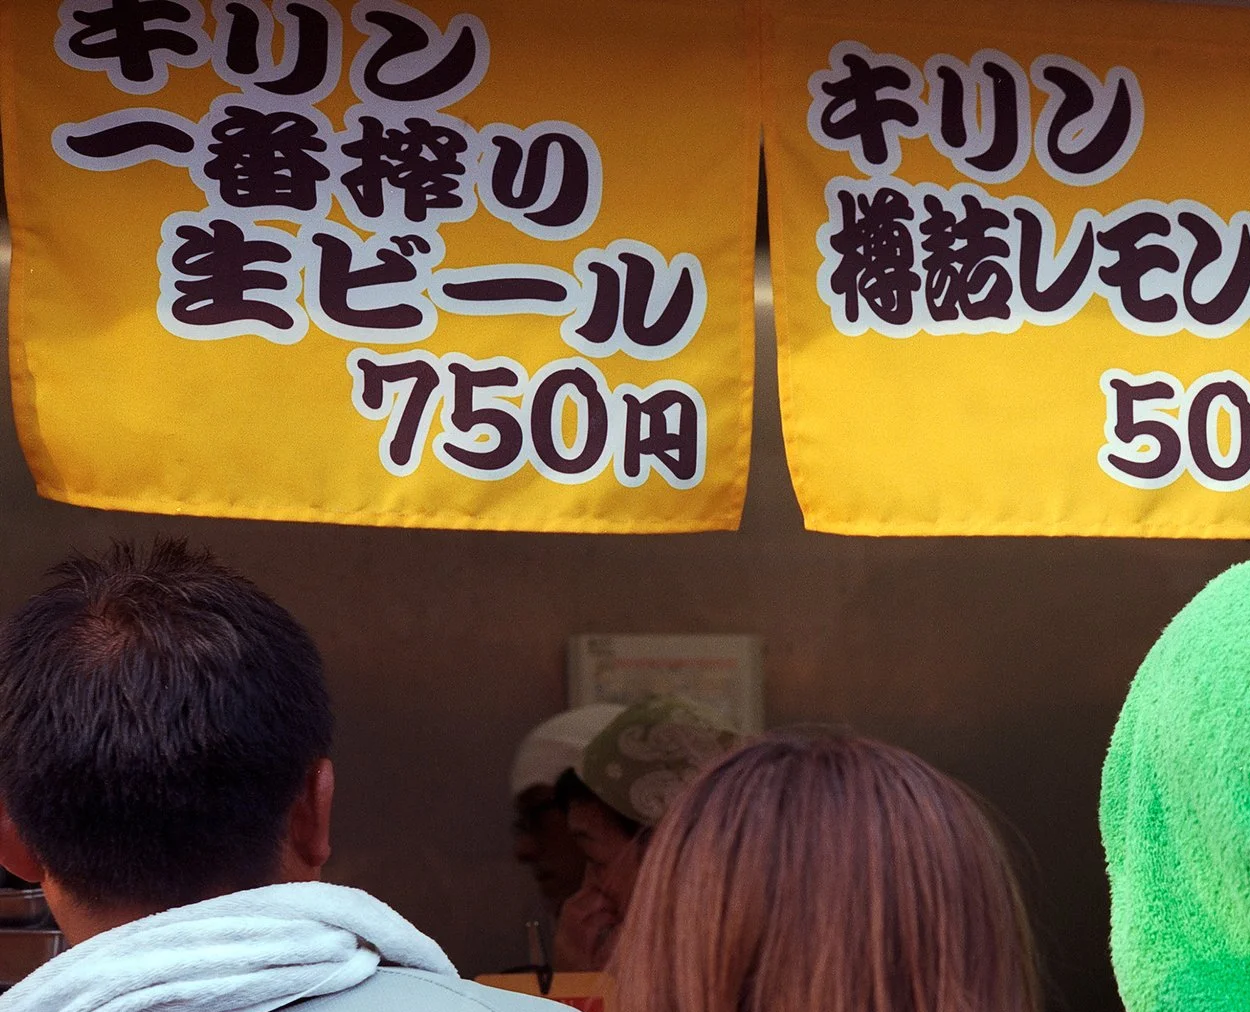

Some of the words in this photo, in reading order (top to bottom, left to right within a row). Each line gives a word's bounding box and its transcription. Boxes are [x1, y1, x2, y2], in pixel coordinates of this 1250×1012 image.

[65, 1, 479, 101] キリン
[65, 104, 592, 227] 一番搾り
[820, 53, 1133, 176] キリン
[169, 224, 696, 347] 生ビール
[360, 357, 699, 481] 750円
